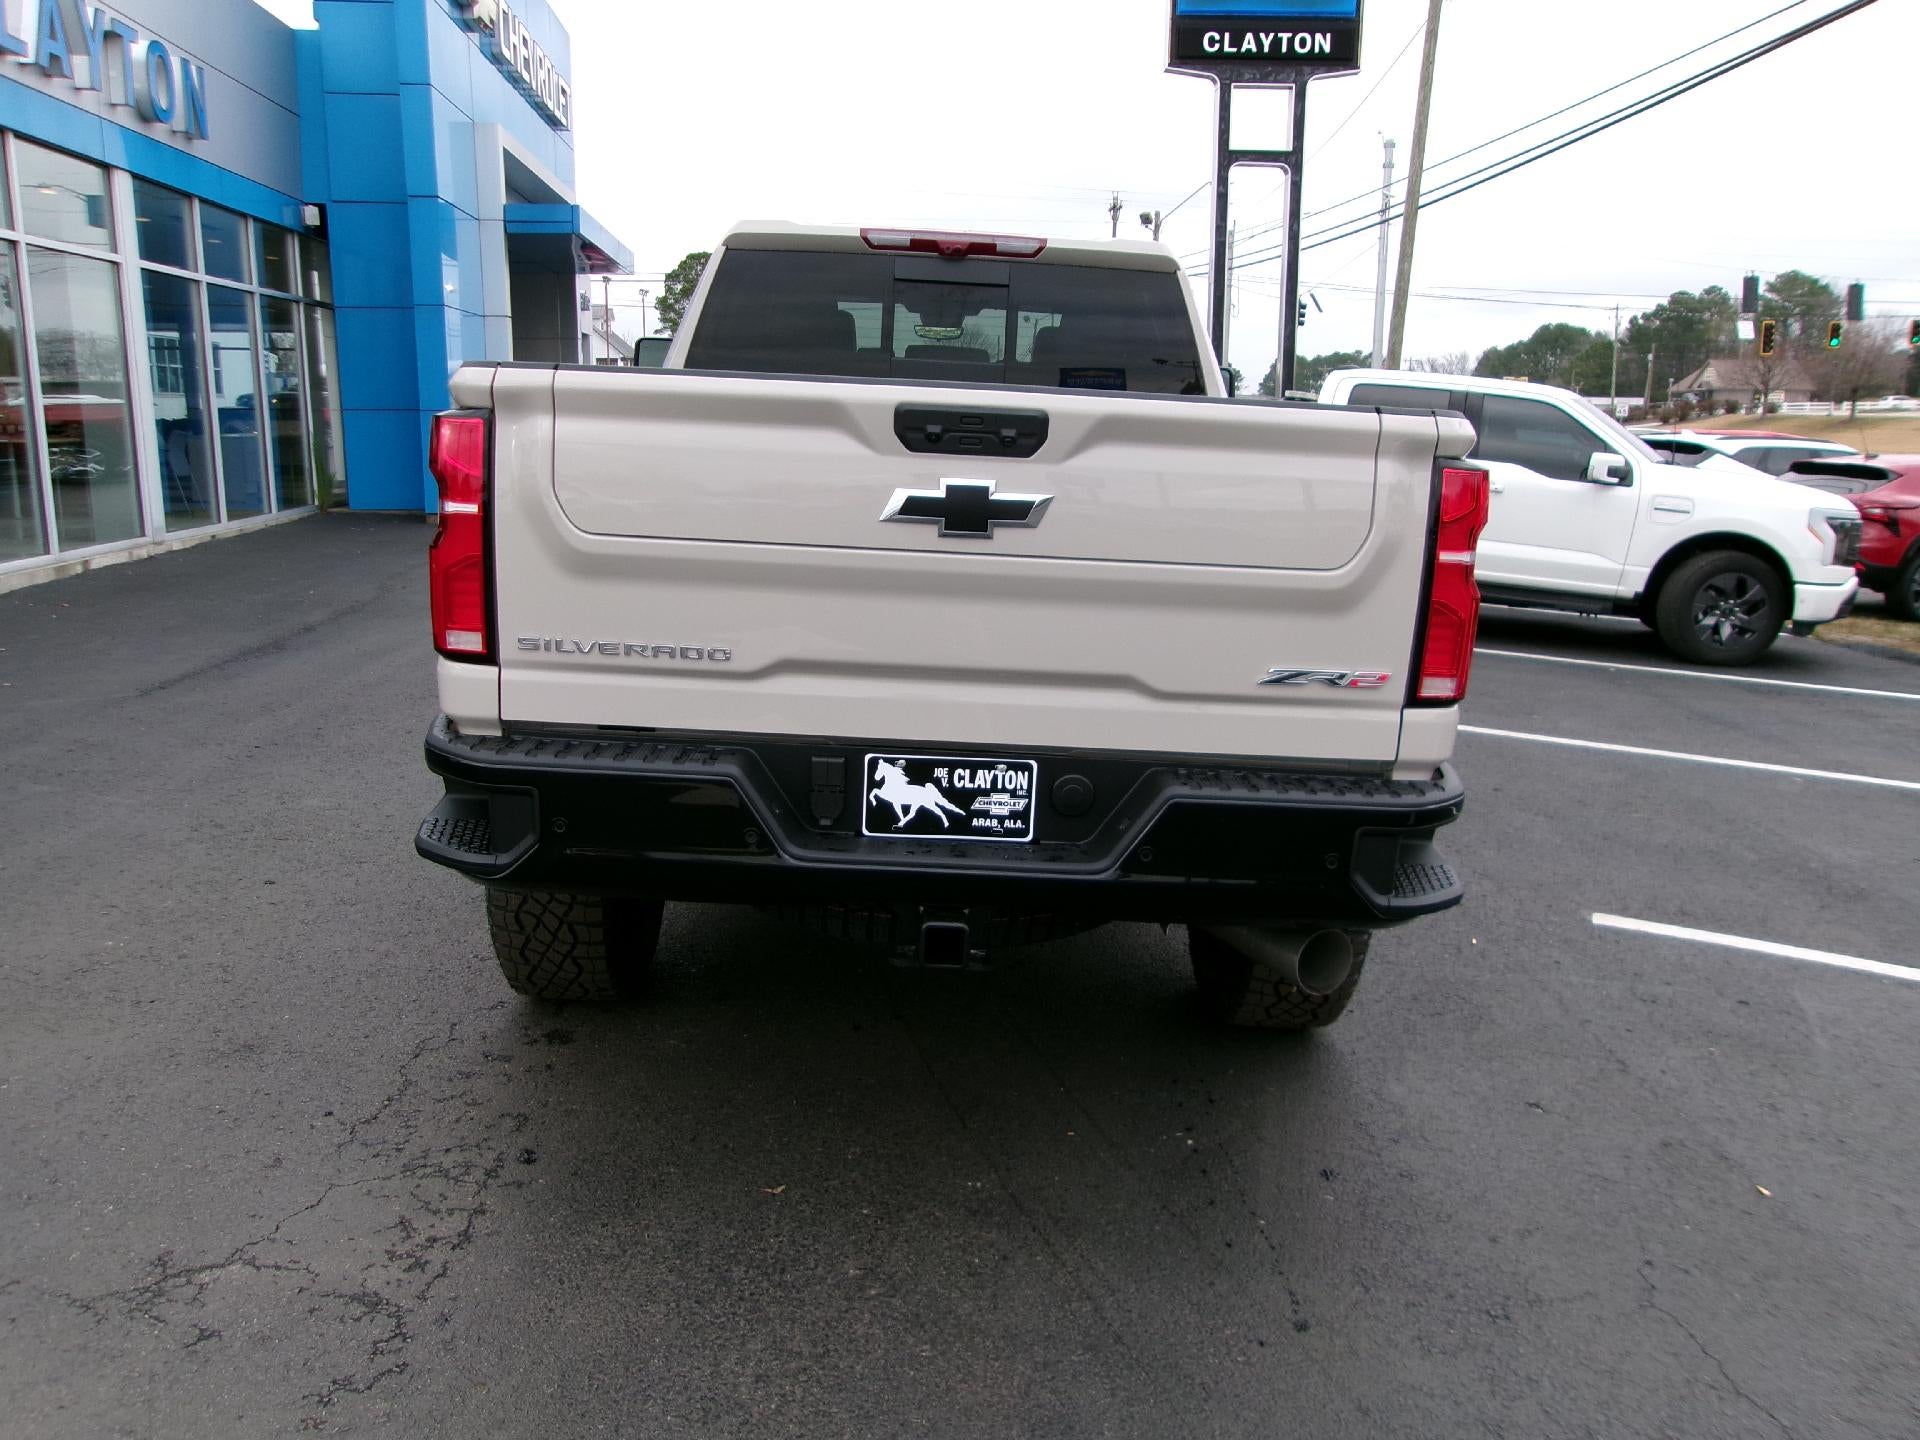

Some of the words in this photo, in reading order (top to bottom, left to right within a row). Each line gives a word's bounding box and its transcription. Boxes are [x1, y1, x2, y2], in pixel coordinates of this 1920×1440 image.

[1202, 31, 1331, 54] CLAYTON
[498, 0, 572, 131] CHEVROLET
[517, 636, 732, 661] SILVERADO
[1257, 668, 1392, 688] ZR2
[933, 767, 949, 778] JOE
[941, 777, 950, 788] V.
[953, 768, 1029, 790] CLAYTON
[978, 799, 1022, 808] CHEVROLET
[971, 818, 1001, 828] ARAB,
[1003, 819, 1026, 829] ALA.
